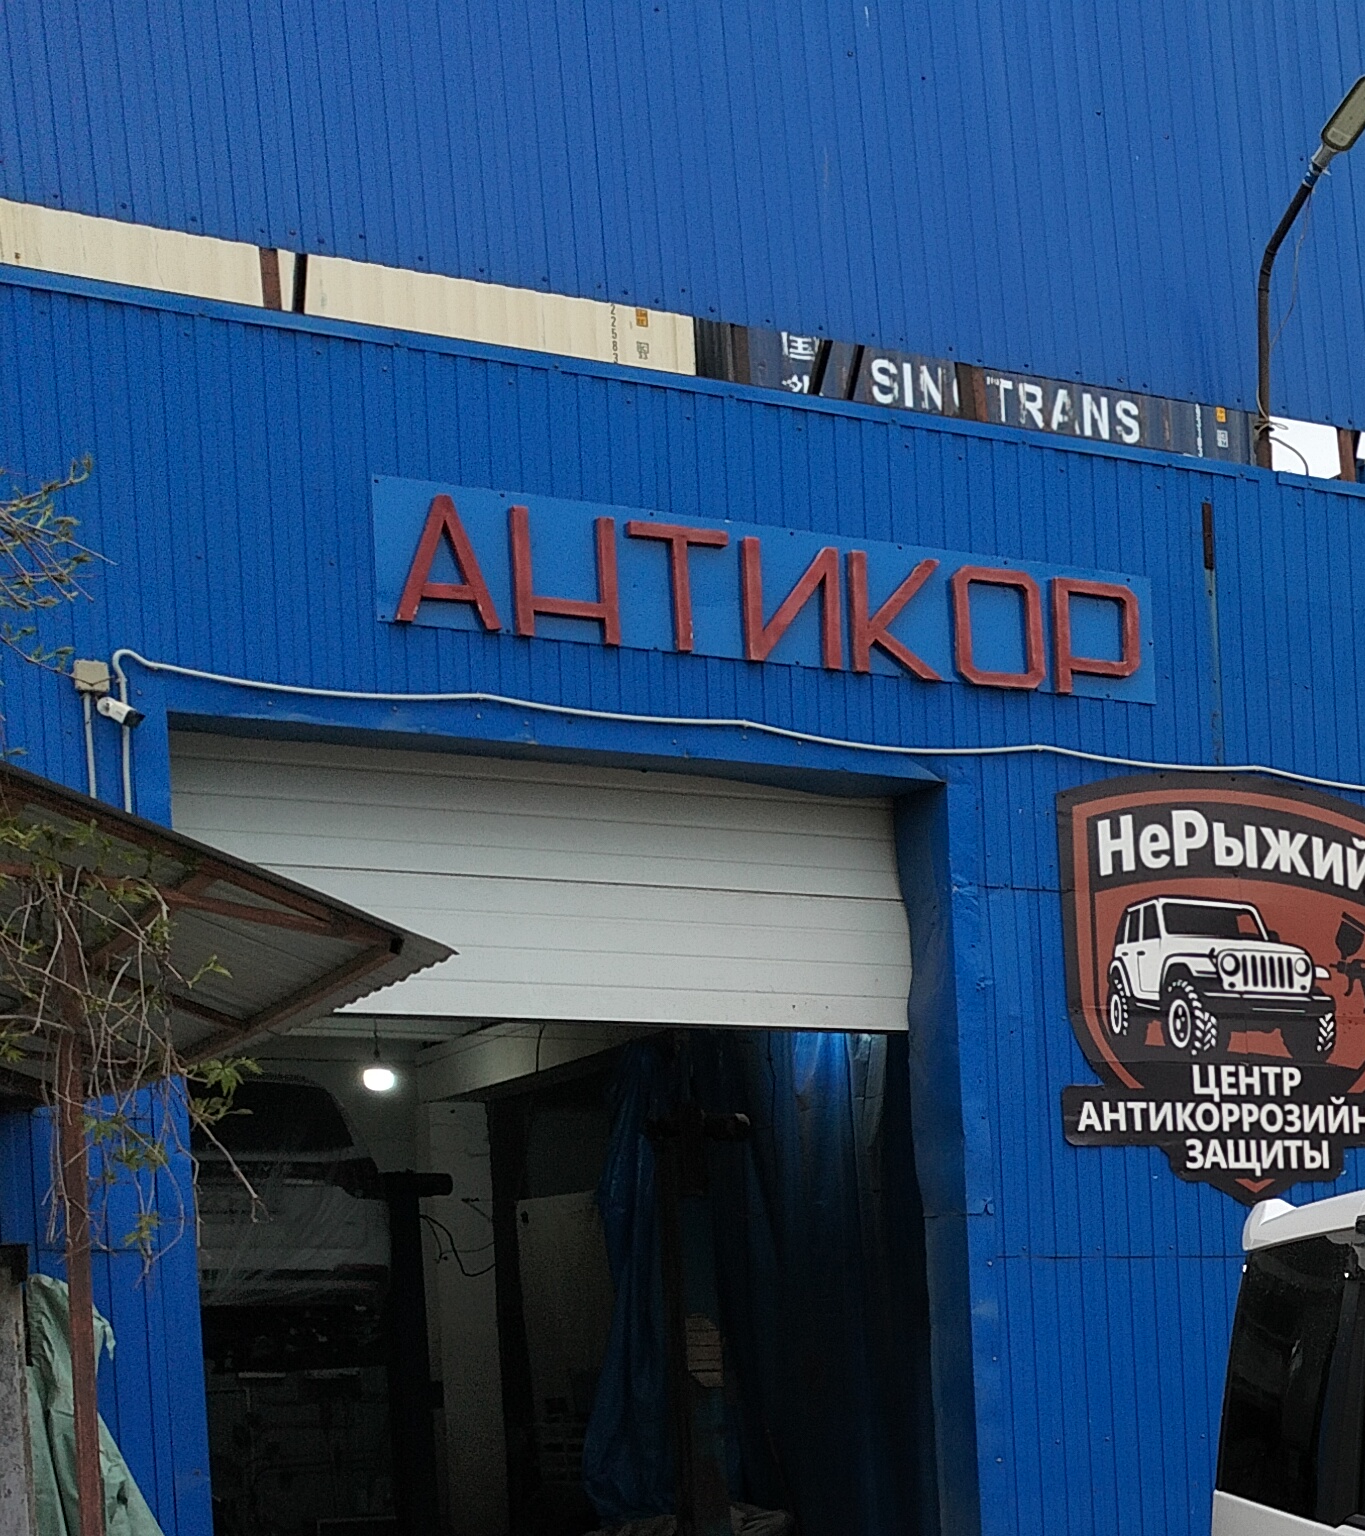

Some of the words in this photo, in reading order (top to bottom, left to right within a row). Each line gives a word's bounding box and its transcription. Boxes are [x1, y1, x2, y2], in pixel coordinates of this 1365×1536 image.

[395, 493, 1141, 694] АНТИКОР
[1192, 1064, 1301, 1102] ЦЕНТР
[1185, 1139, 1330, 1176] ЗАЩИТЫ
